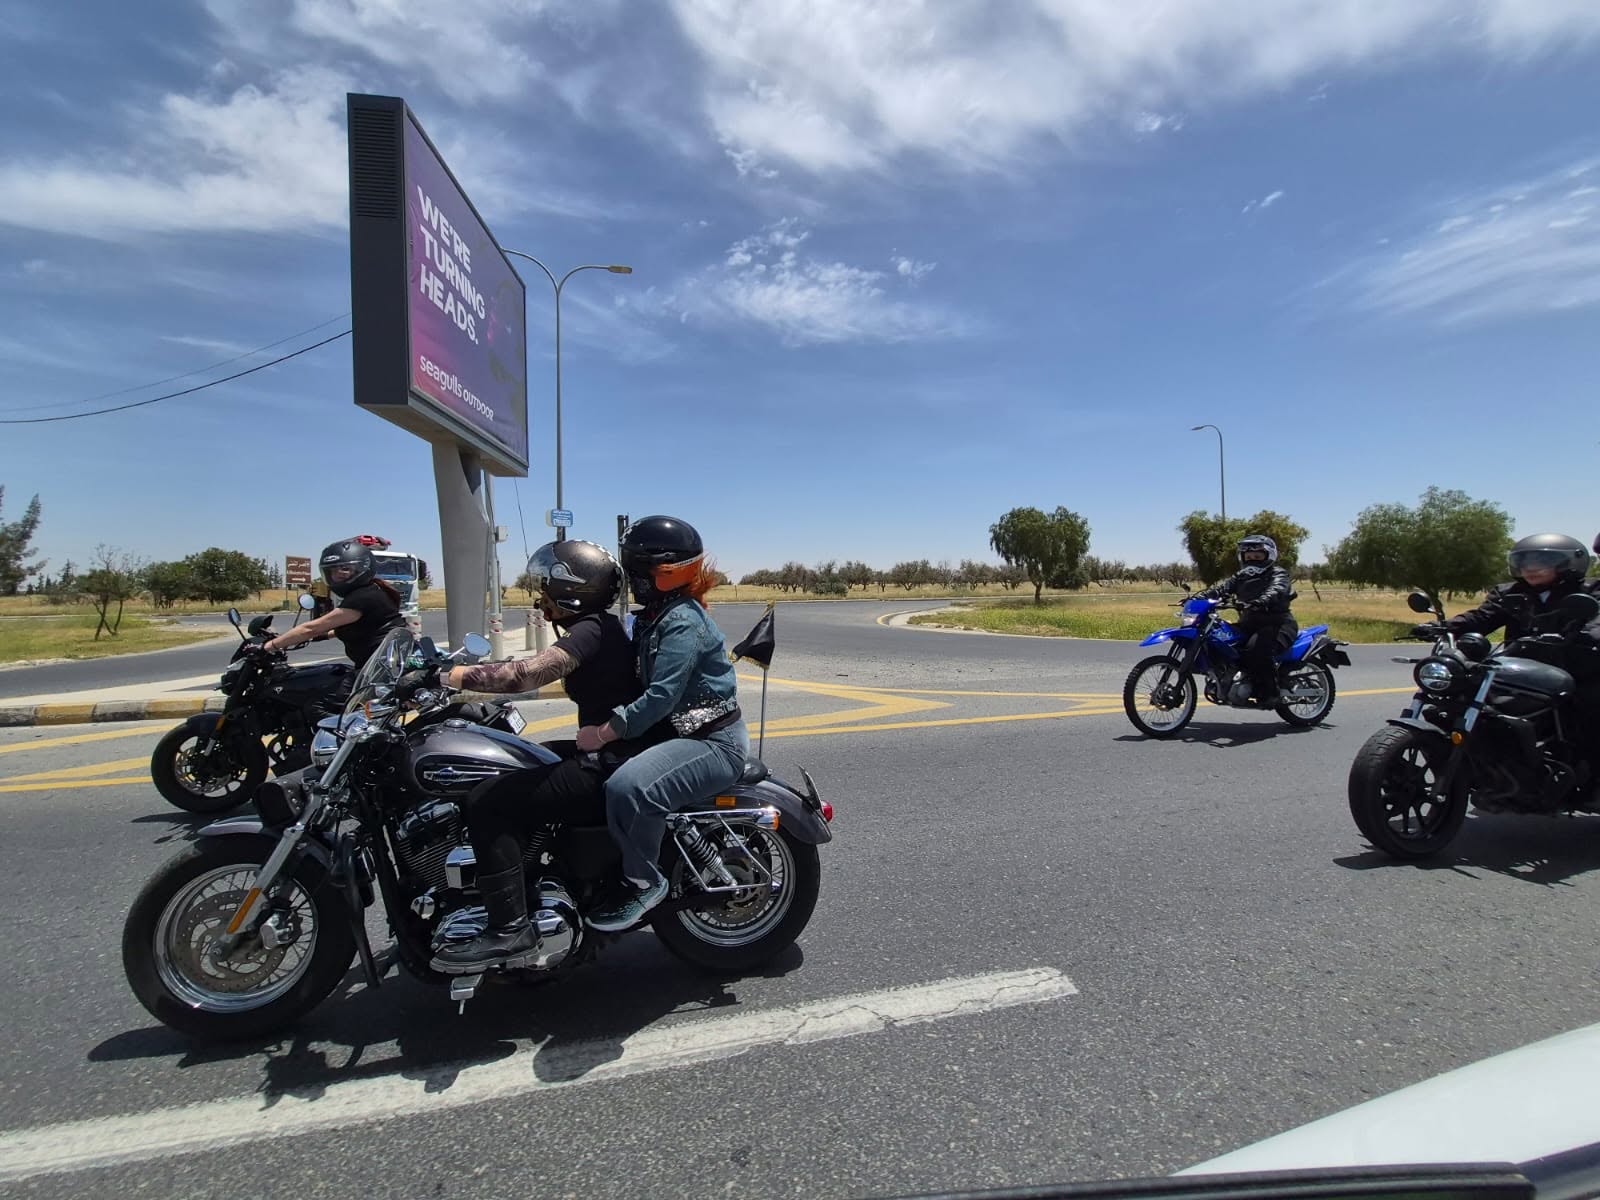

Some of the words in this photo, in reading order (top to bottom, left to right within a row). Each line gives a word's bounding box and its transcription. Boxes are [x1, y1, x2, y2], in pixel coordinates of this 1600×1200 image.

[417, 184, 472, 274] WE'RE
[420, 223, 486, 320] TURNING
[420, 263, 478, 345] HEADS.
[420, 355, 462, 398] seagulls
[463, 389, 494, 421] OUTDOOR
